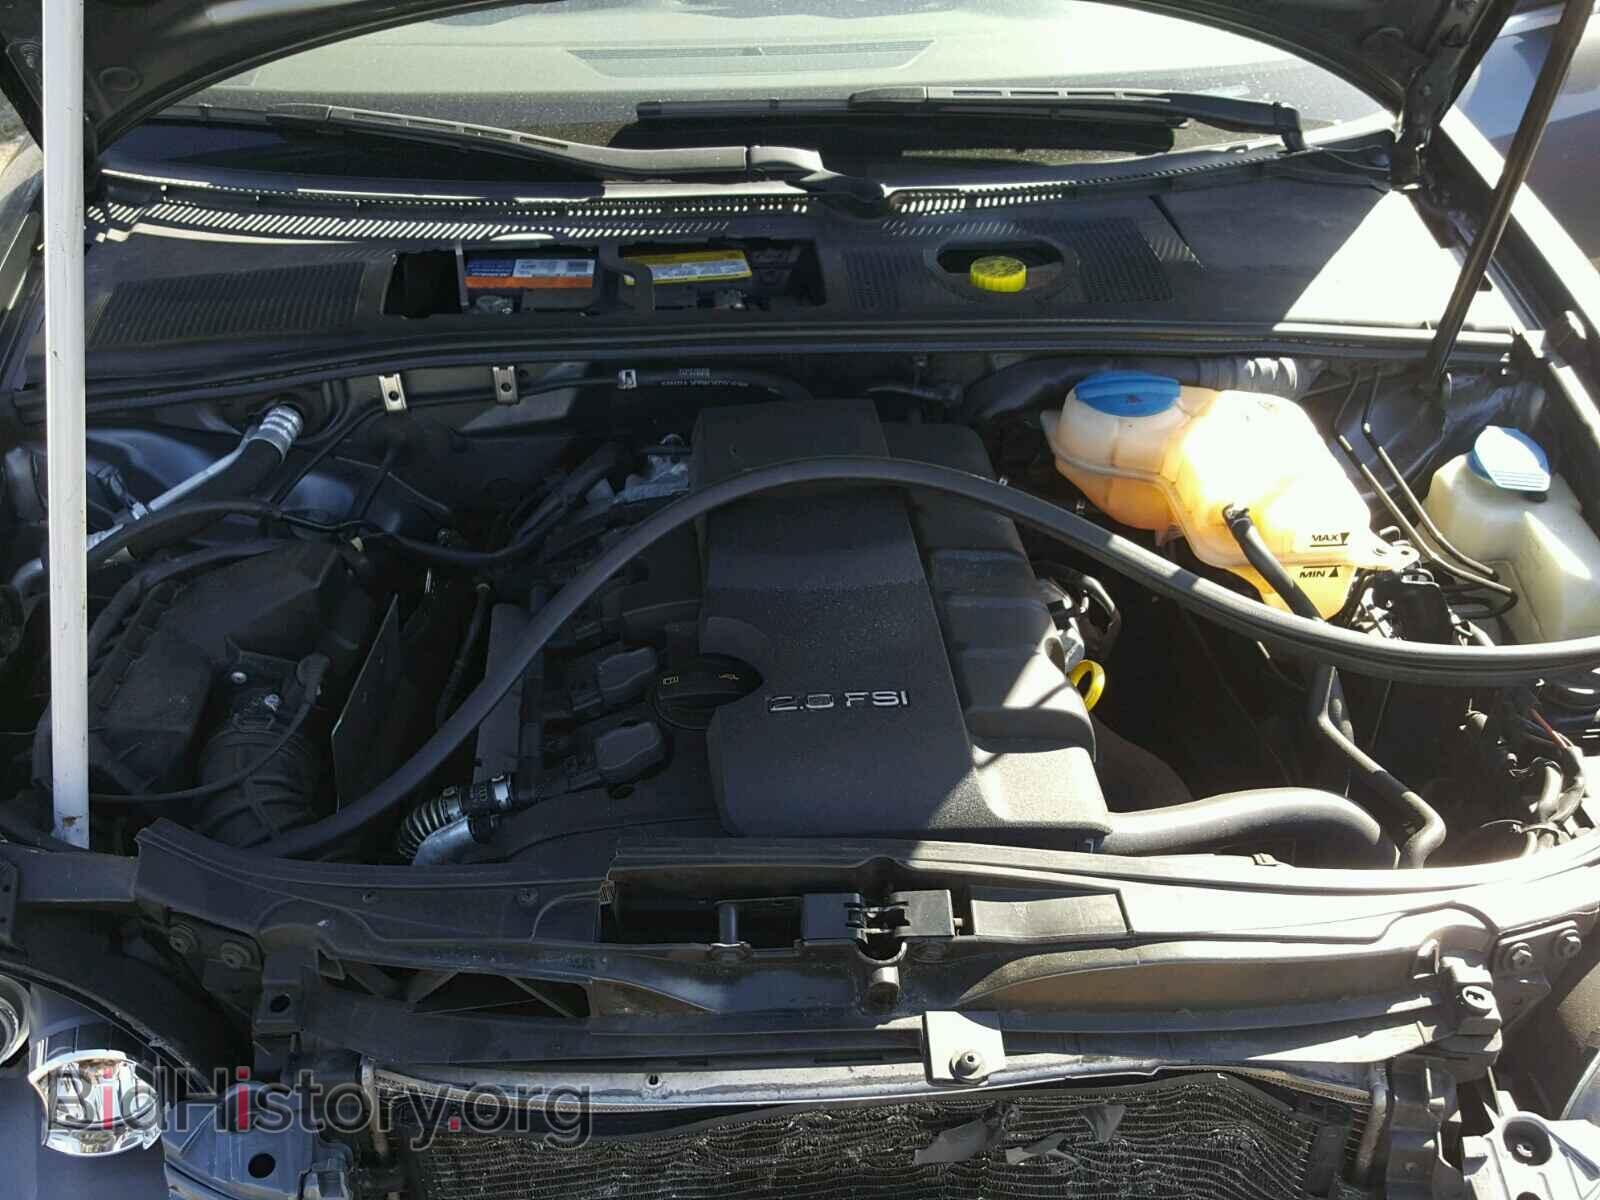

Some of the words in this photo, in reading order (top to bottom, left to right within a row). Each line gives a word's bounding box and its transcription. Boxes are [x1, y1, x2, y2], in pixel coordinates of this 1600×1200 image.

[1311, 534, 1338, 542] MAX
[1299, 570, 1326, 578] MIN
[769, 694, 835, 711] 2.0
[844, 690, 908, 707] FSI
